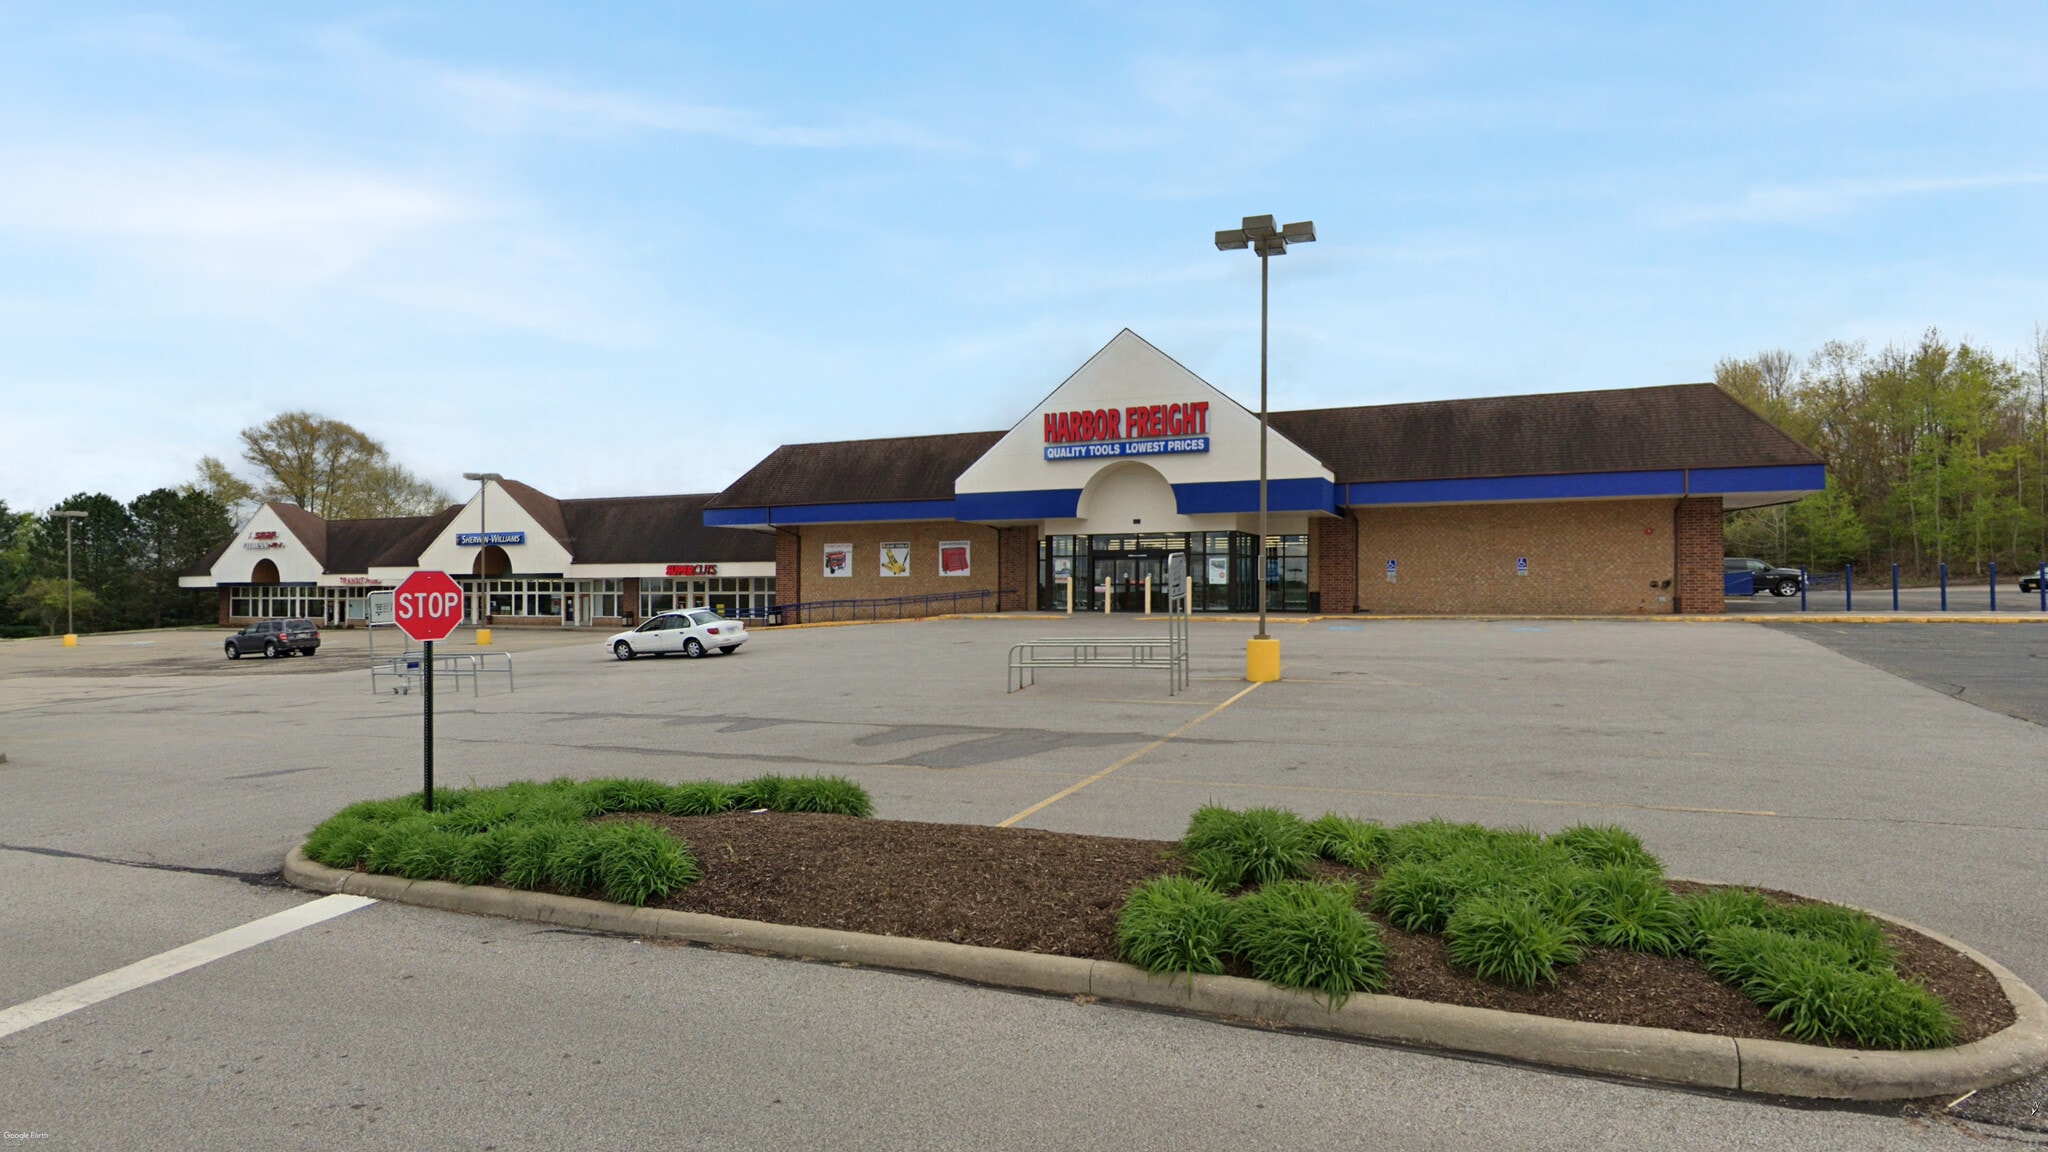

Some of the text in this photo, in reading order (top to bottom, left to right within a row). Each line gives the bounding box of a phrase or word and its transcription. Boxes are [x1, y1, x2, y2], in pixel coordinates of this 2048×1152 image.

[1044, 401, 1209, 443] HARBOR FREIGHT
[1047, 439, 1205, 458] QUALITY TOOLS LOWEST PRICES
[461, 534, 521, 544] SHERWN-WILLIAMS
[665, 564, 718, 576] SUPERCUTS
[398, 591, 459, 619] STOP
